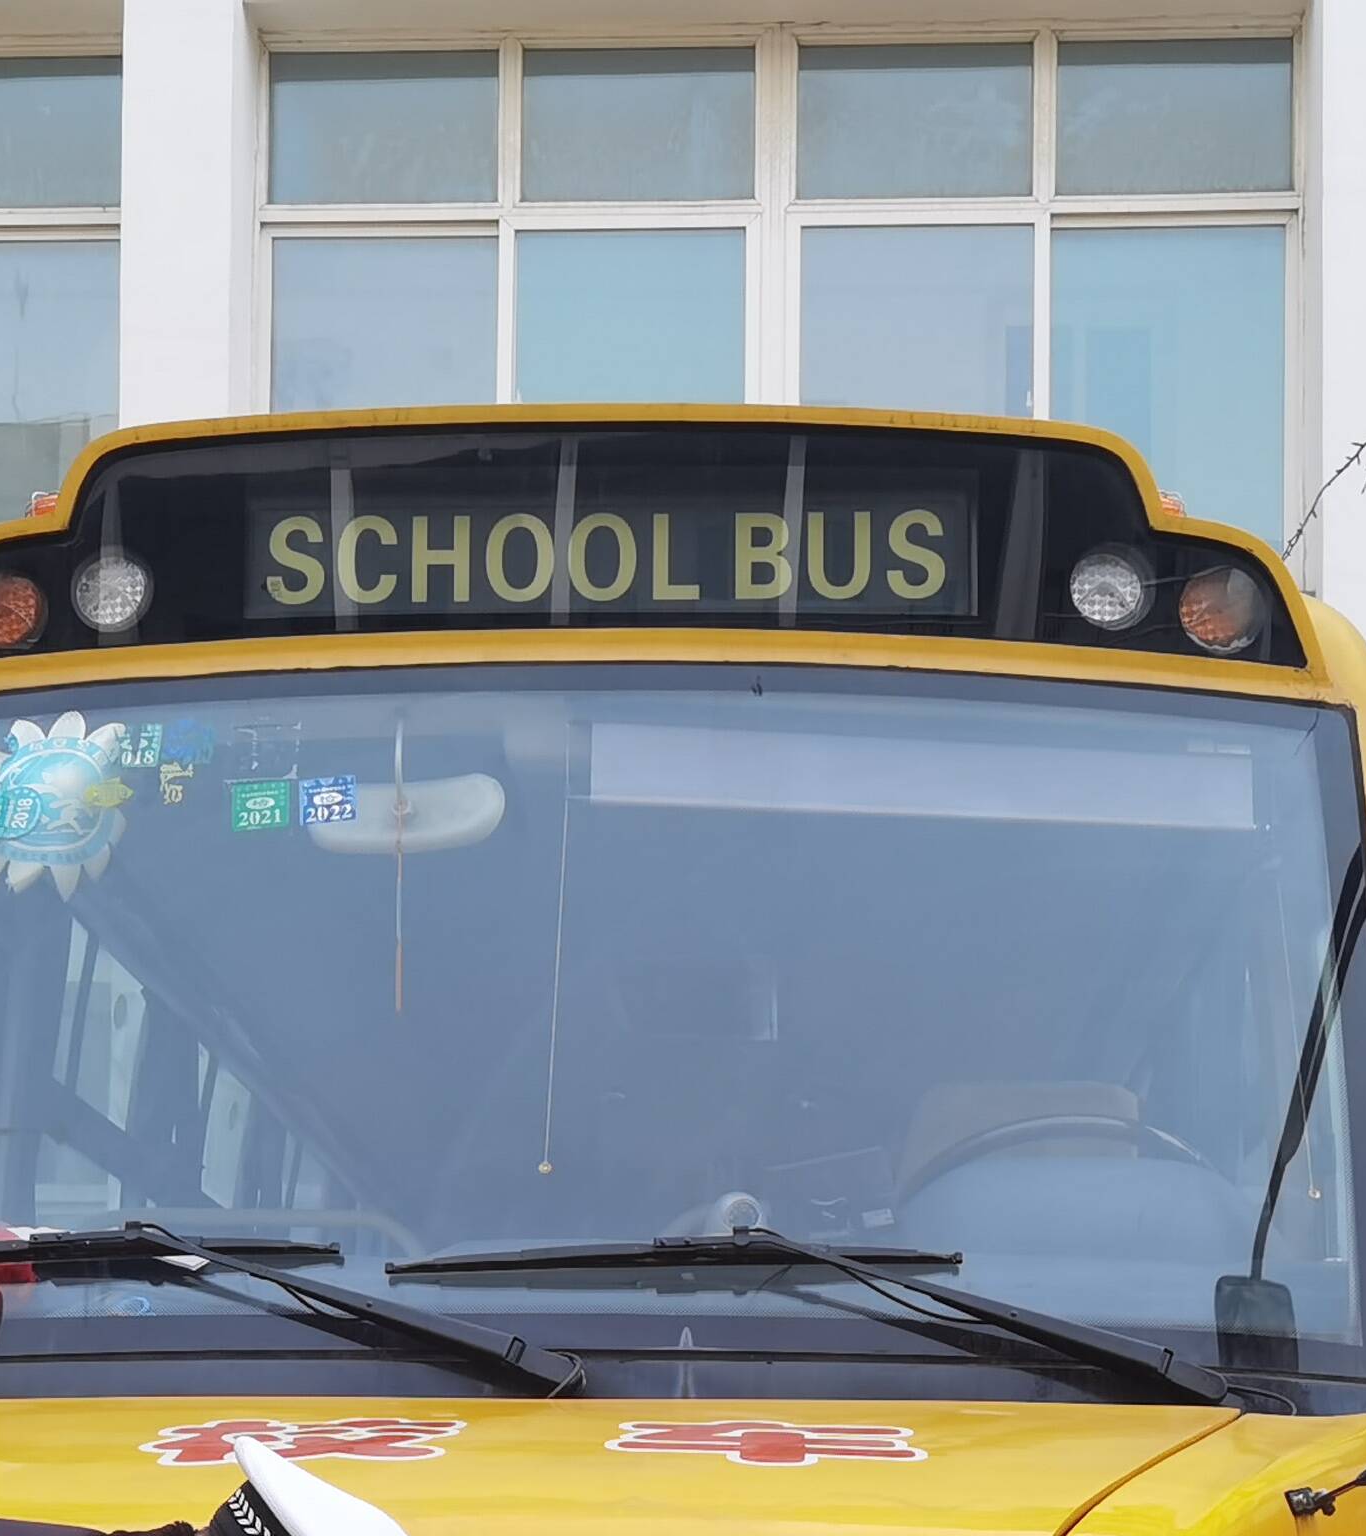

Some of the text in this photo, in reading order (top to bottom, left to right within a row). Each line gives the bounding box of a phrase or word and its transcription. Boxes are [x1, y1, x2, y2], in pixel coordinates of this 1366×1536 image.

[266, 509, 946, 605] SCHOOL BUS
[11, 798, 33, 829] 2018
[235, 808, 283, 828] 2021
[304, 803, 354, 823] 2022
